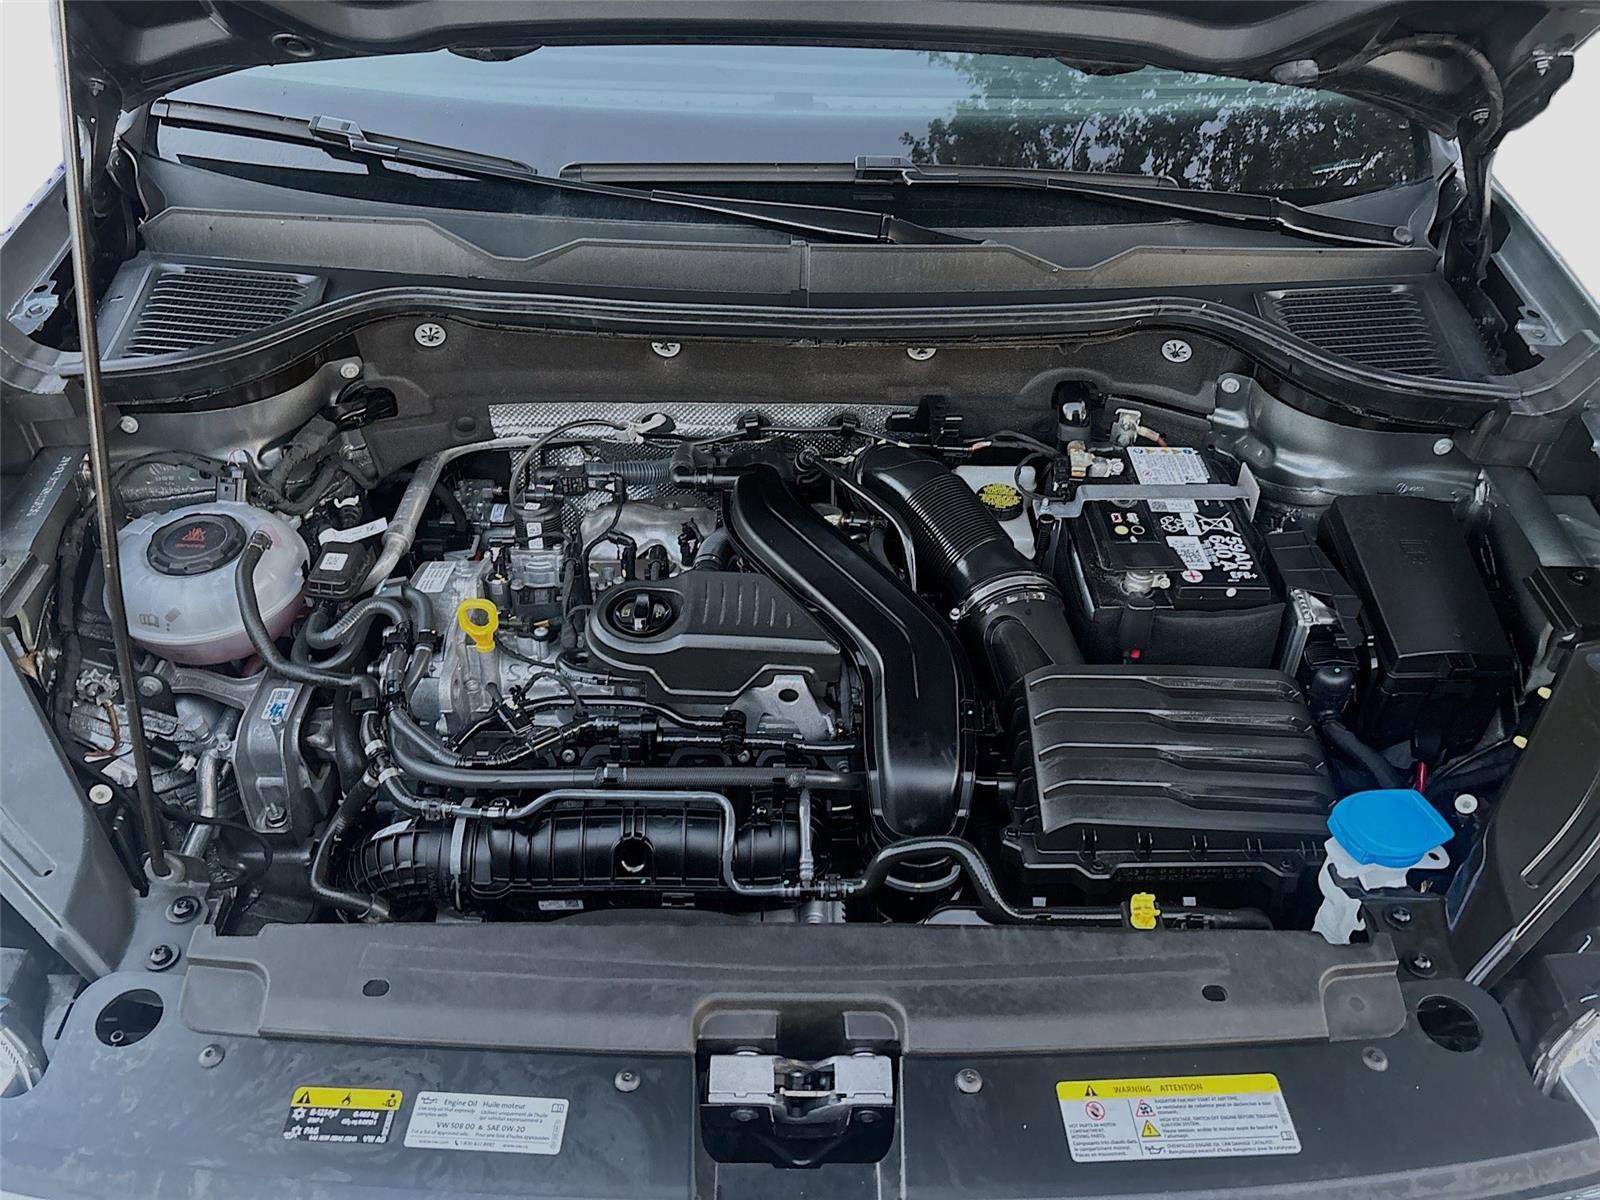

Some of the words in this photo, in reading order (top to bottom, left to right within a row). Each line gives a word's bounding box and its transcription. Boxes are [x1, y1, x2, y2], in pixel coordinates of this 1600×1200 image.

[1225, 536, 1254, 570] 59Ah
[1113, 1085, 1152, 1094] WARNING
[1160, 1083, 1204, 1092] ATTENTION
[444, 1099, 466, 1107] Engine
